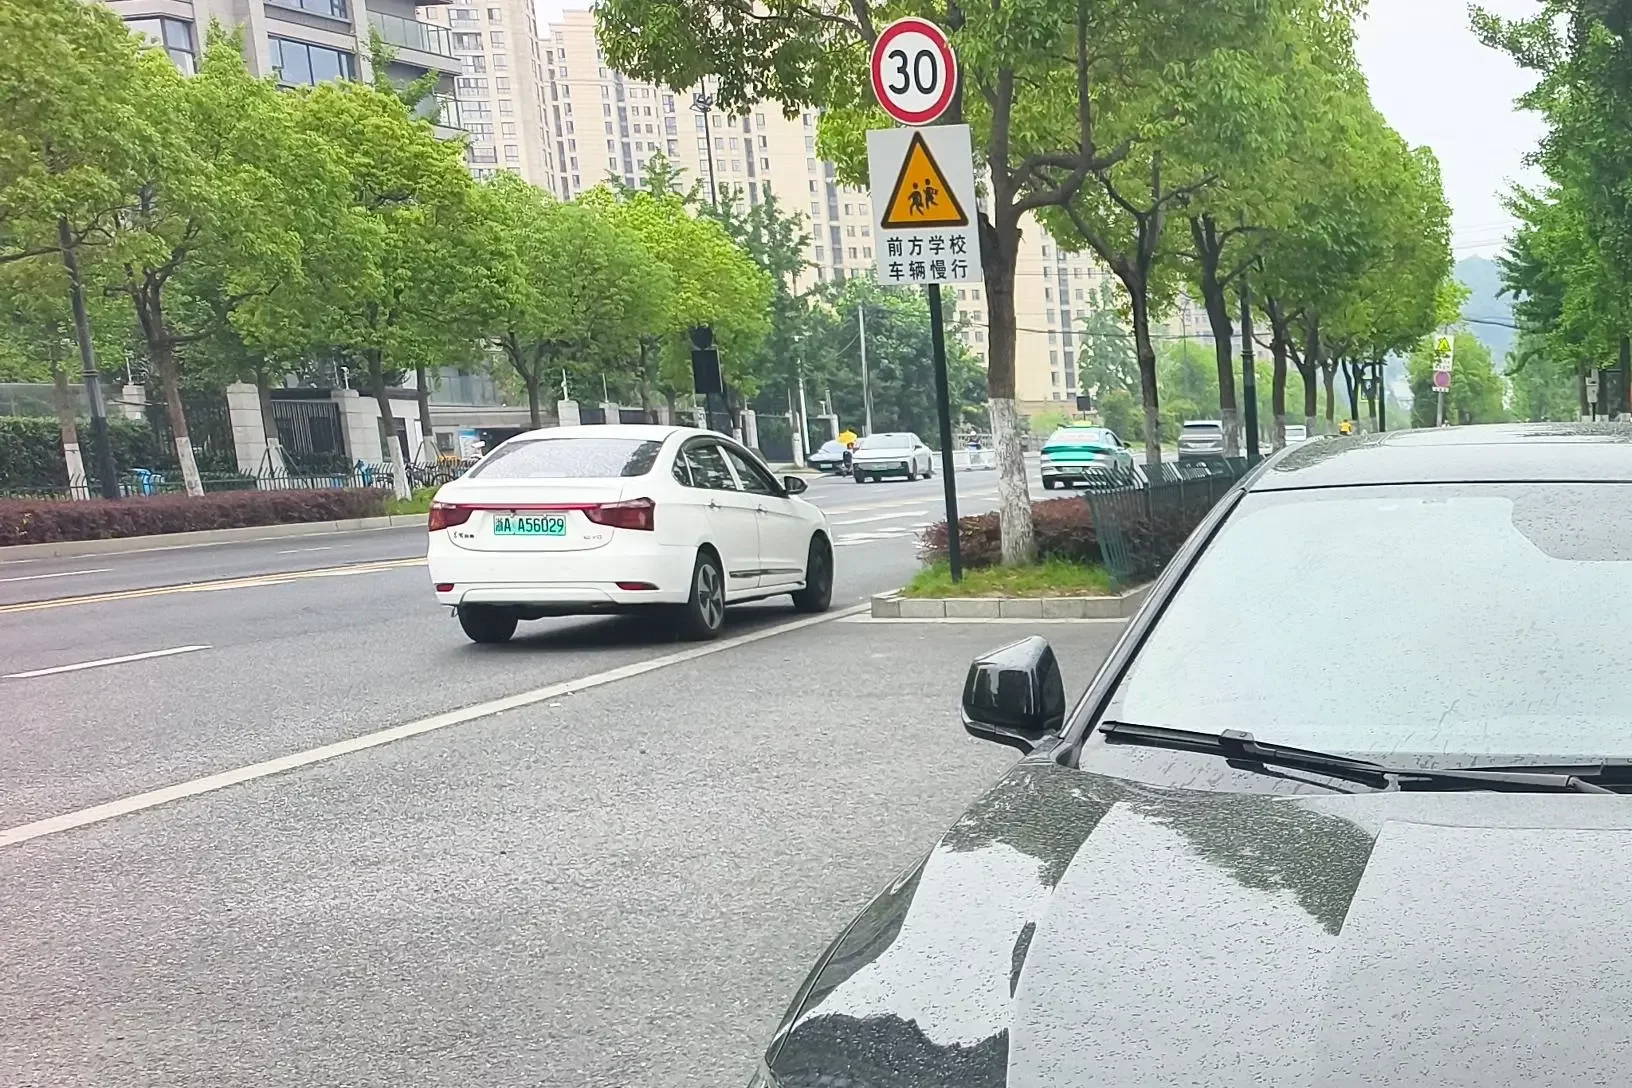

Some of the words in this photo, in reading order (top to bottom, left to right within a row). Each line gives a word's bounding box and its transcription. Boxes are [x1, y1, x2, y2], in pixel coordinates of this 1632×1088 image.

[888, 49, 938, 95] 30
[887, 234, 967, 257] 前方学校
[888, 258, 968, 281] 车辆慢行
